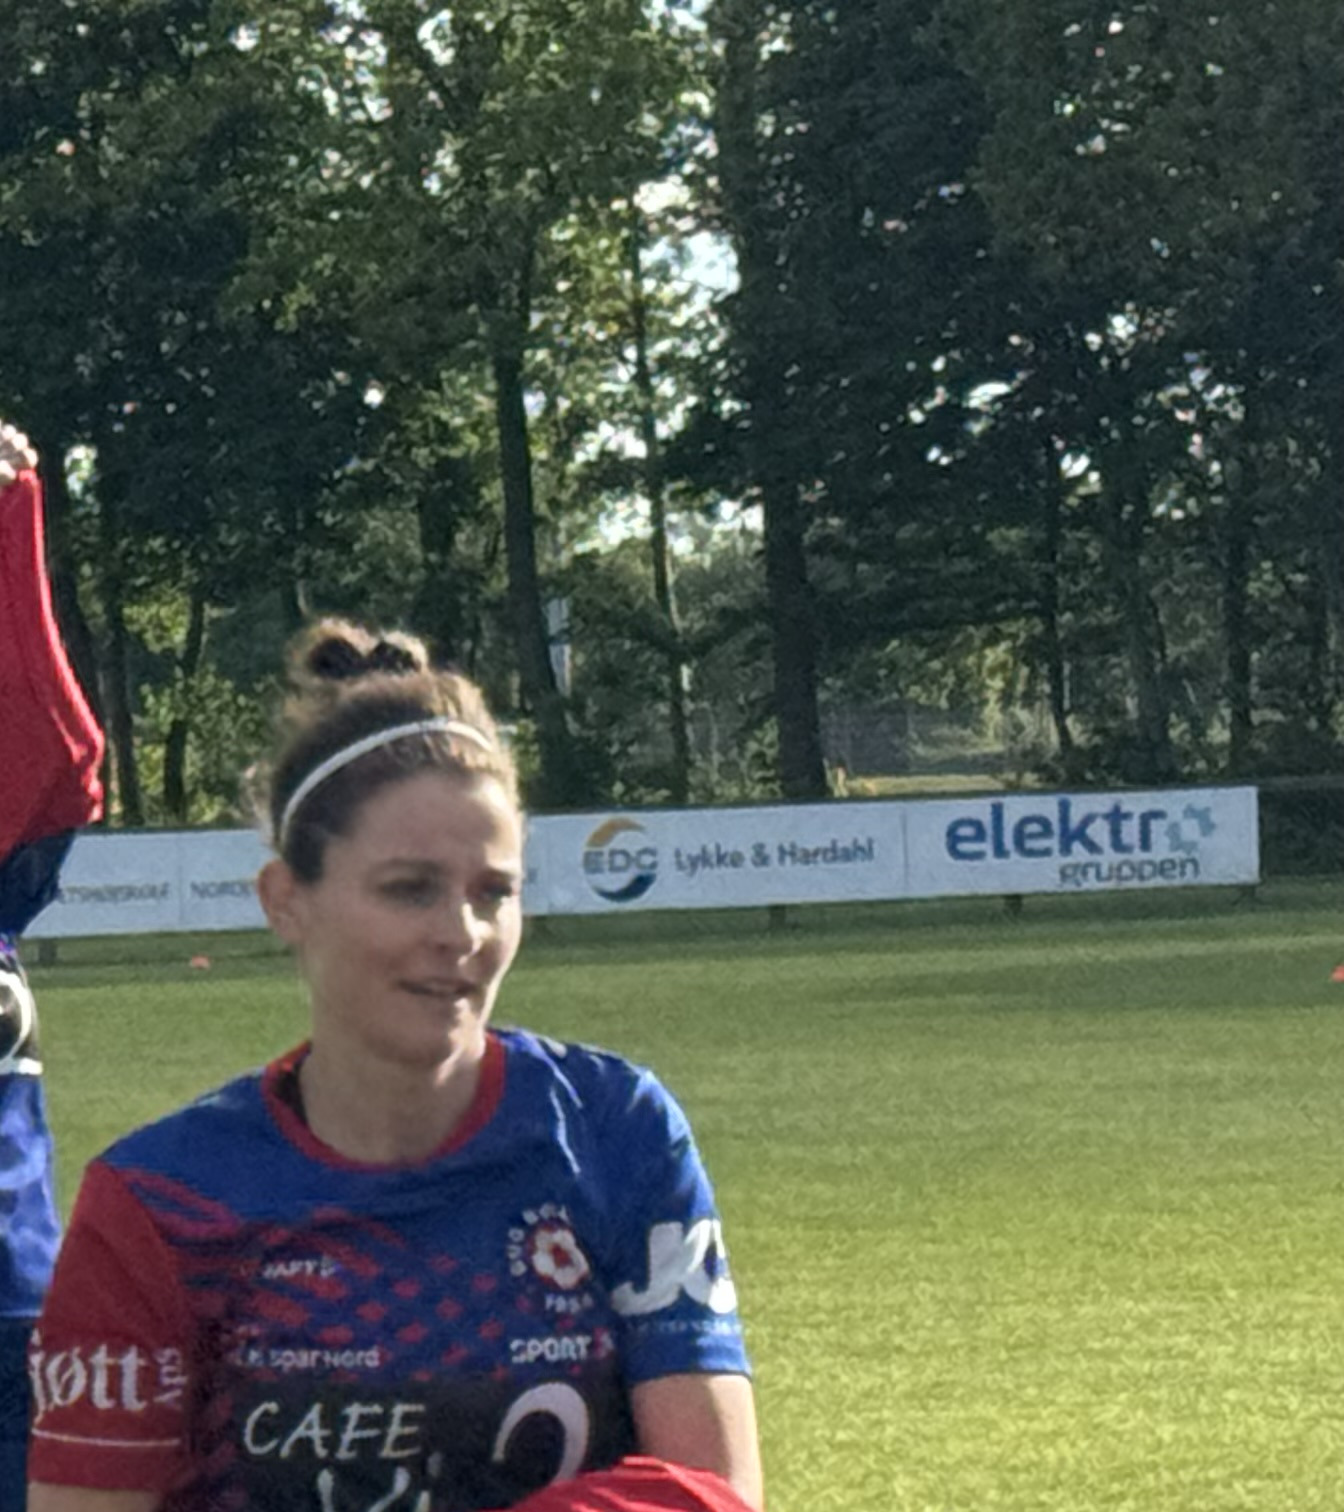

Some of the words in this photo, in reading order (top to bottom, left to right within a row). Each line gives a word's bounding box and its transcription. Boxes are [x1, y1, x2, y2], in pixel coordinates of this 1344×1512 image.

[583, 847, 658, 875] EDC
[674, 844, 745, 877] Lykke
[752, 844, 770, 868] &
[778, 837, 875, 867] Hardahl
[1059, 857, 1200, 886] gruppen
[510, 1336, 592, 1364] SPORT
[243, 1402, 426, 1462] CAFE
